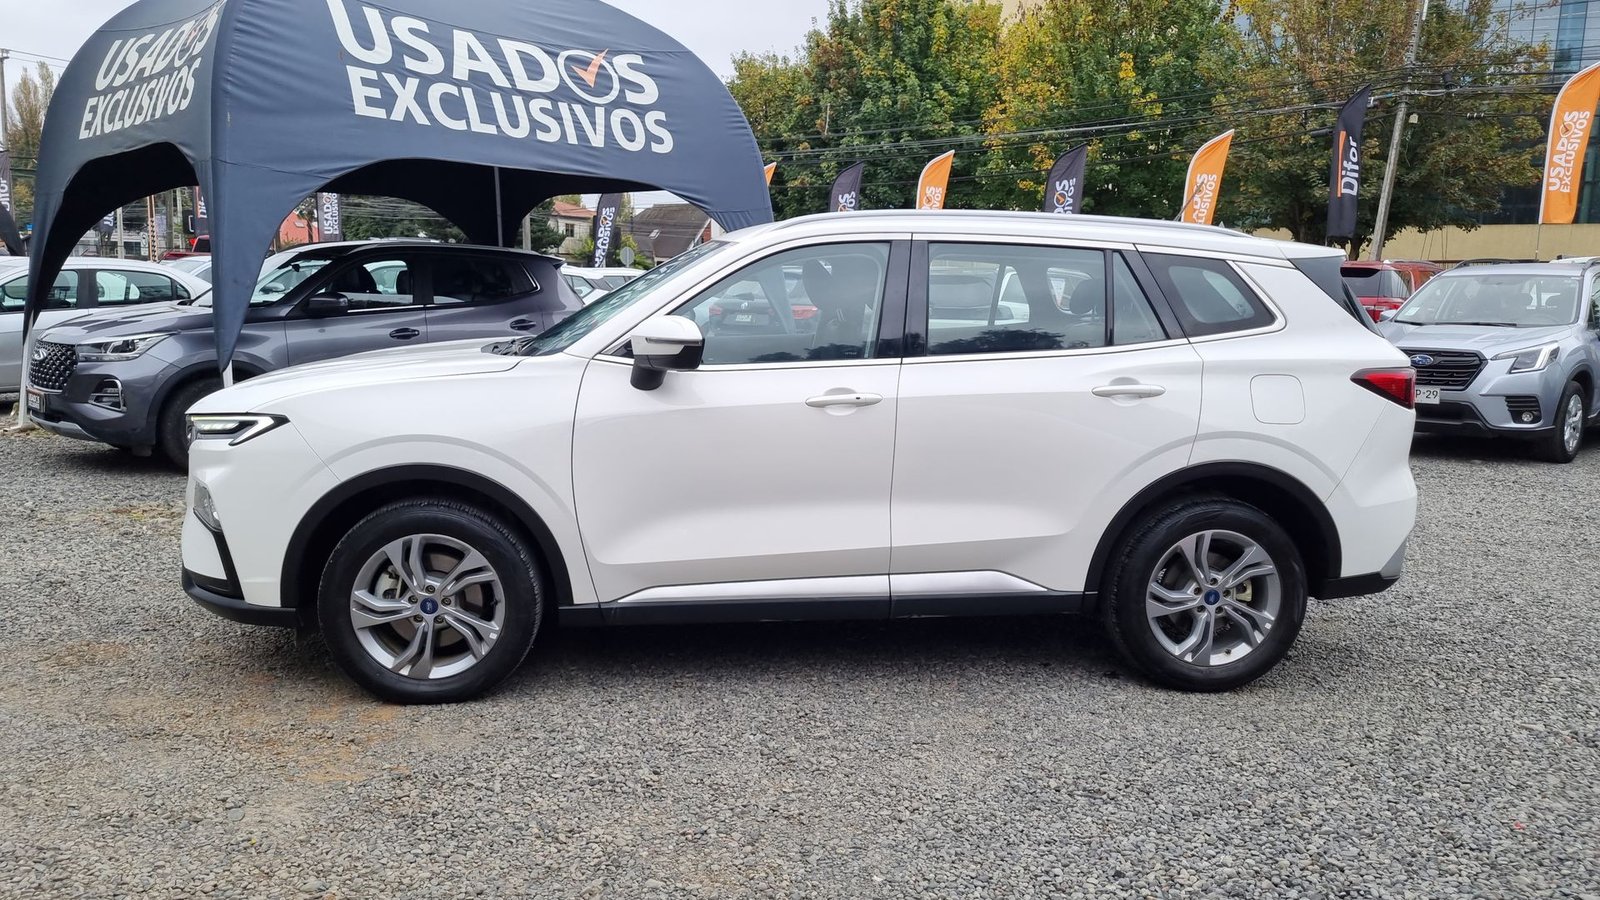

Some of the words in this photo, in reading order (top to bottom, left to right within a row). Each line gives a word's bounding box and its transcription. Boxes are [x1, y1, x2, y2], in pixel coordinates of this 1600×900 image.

[95, 6, 218, 91] USADOS
[326, 0, 659, 105] USADOS
[79, 57, 202, 140] EXCLUSIVOS
[346, 65, 674, 154] EXCLUSIVOS
[1341, 136, 1359, 196] Difor
[1549, 110, 1579, 191] USADOS
[1559, 110, 1591, 193] EXCLUSIVOS
[1196, 174, 1217, 225] LUSIVOS
